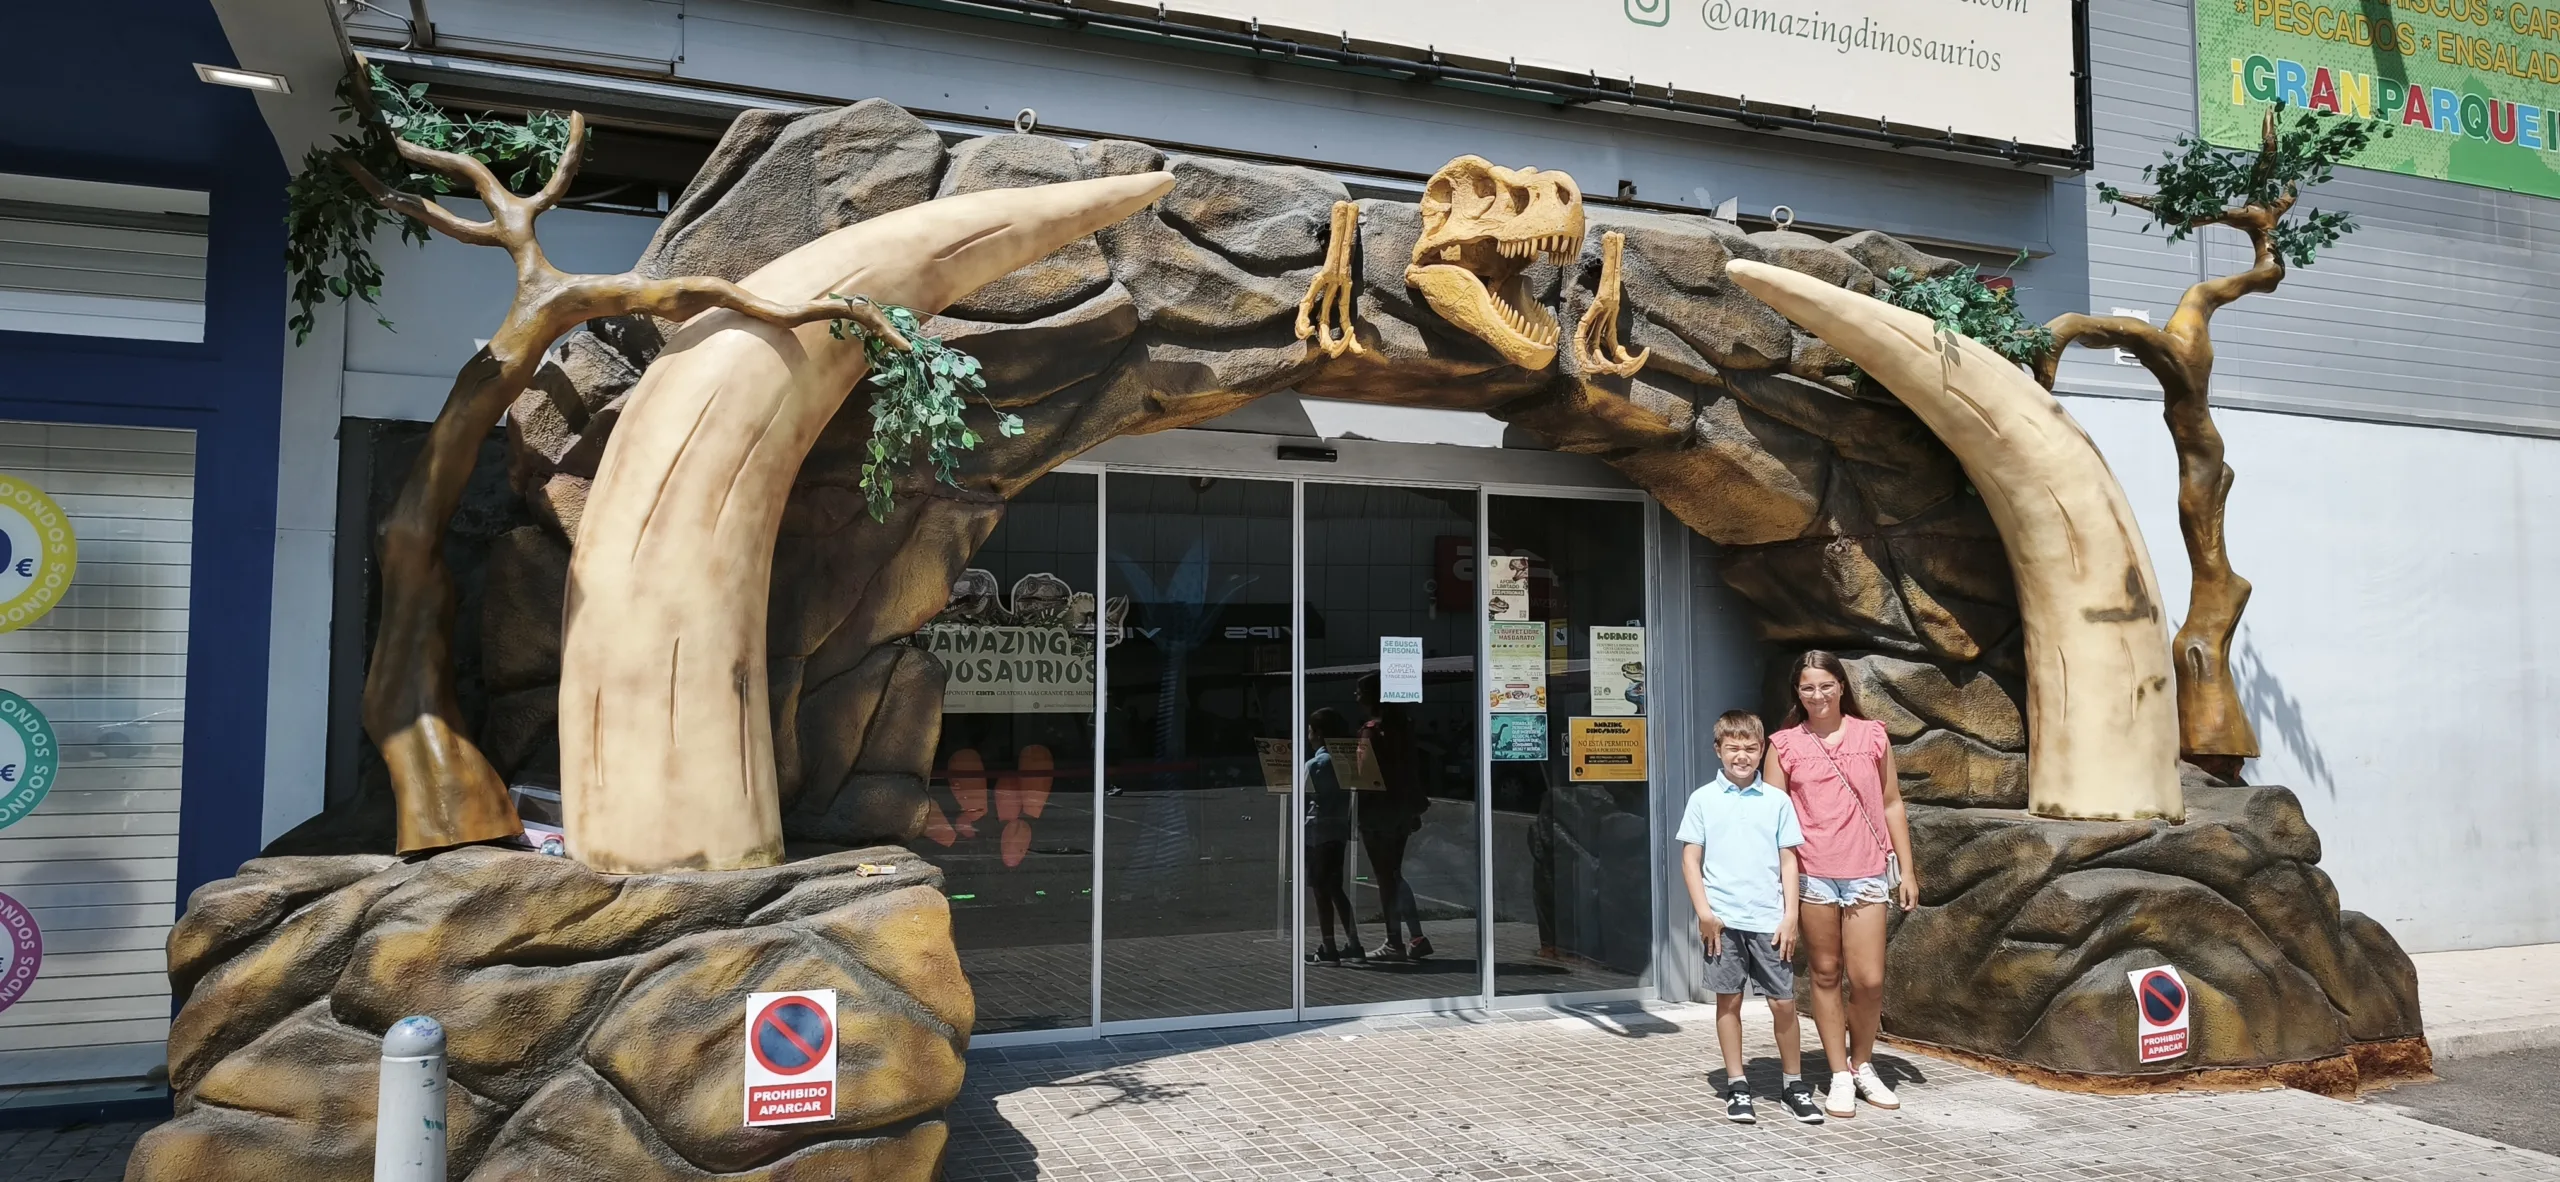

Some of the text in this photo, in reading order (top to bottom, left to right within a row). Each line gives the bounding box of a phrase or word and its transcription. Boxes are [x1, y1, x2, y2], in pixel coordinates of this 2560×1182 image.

[2253, 0, 2416, 56] PESCADOS
[1701, 0, 2001, 72] @amazingdinosaurios
[2376, 77, 2543, 151] PARQUE
[933, 630, 1067, 656] AMAZING
[1394, 640, 1418, 648] BUSCA
[1383, 647, 1421, 655] PERSONAL
[1383, 691, 1420, 699] AMAZING
[2144, 1032, 2185, 1046] PROHIBIDO
[2148, 1042, 2183, 1055] APARCAR
[753, 1087, 828, 1102] PROHIBIDO
[759, 1101, 821, 1116] APARCAR
